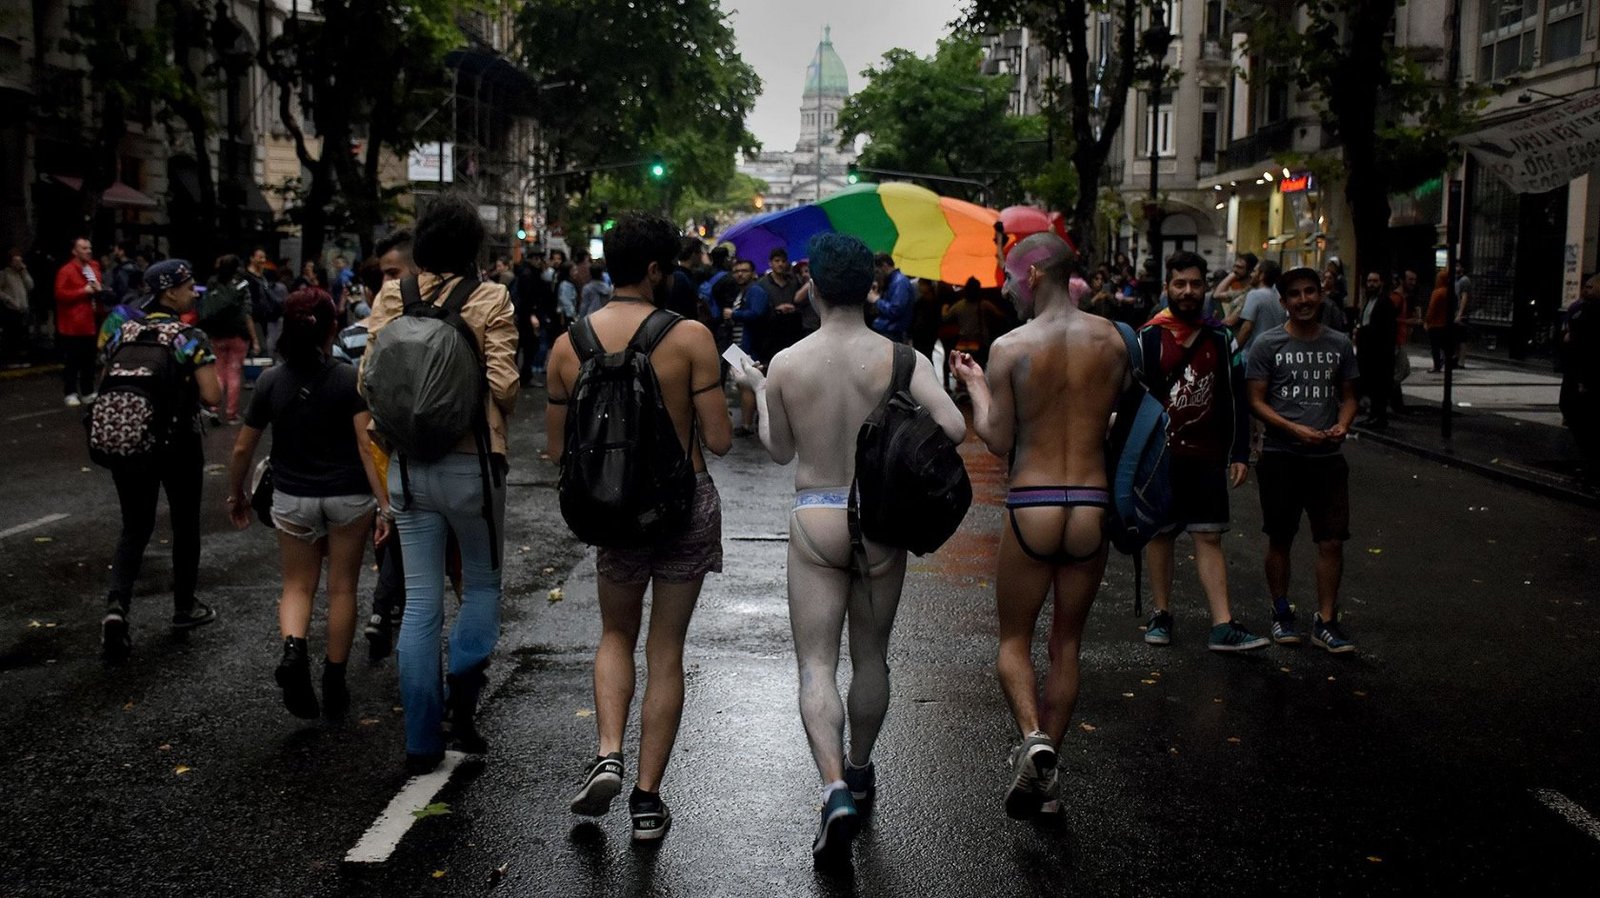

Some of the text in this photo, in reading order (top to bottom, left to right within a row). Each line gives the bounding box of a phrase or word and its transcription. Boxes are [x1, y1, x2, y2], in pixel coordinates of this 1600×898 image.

[1275, 352, 1340, 366] PROTECT
[1291, 369, 1331, 380] YOUR
[639, 819, 656, 828] NIKE
